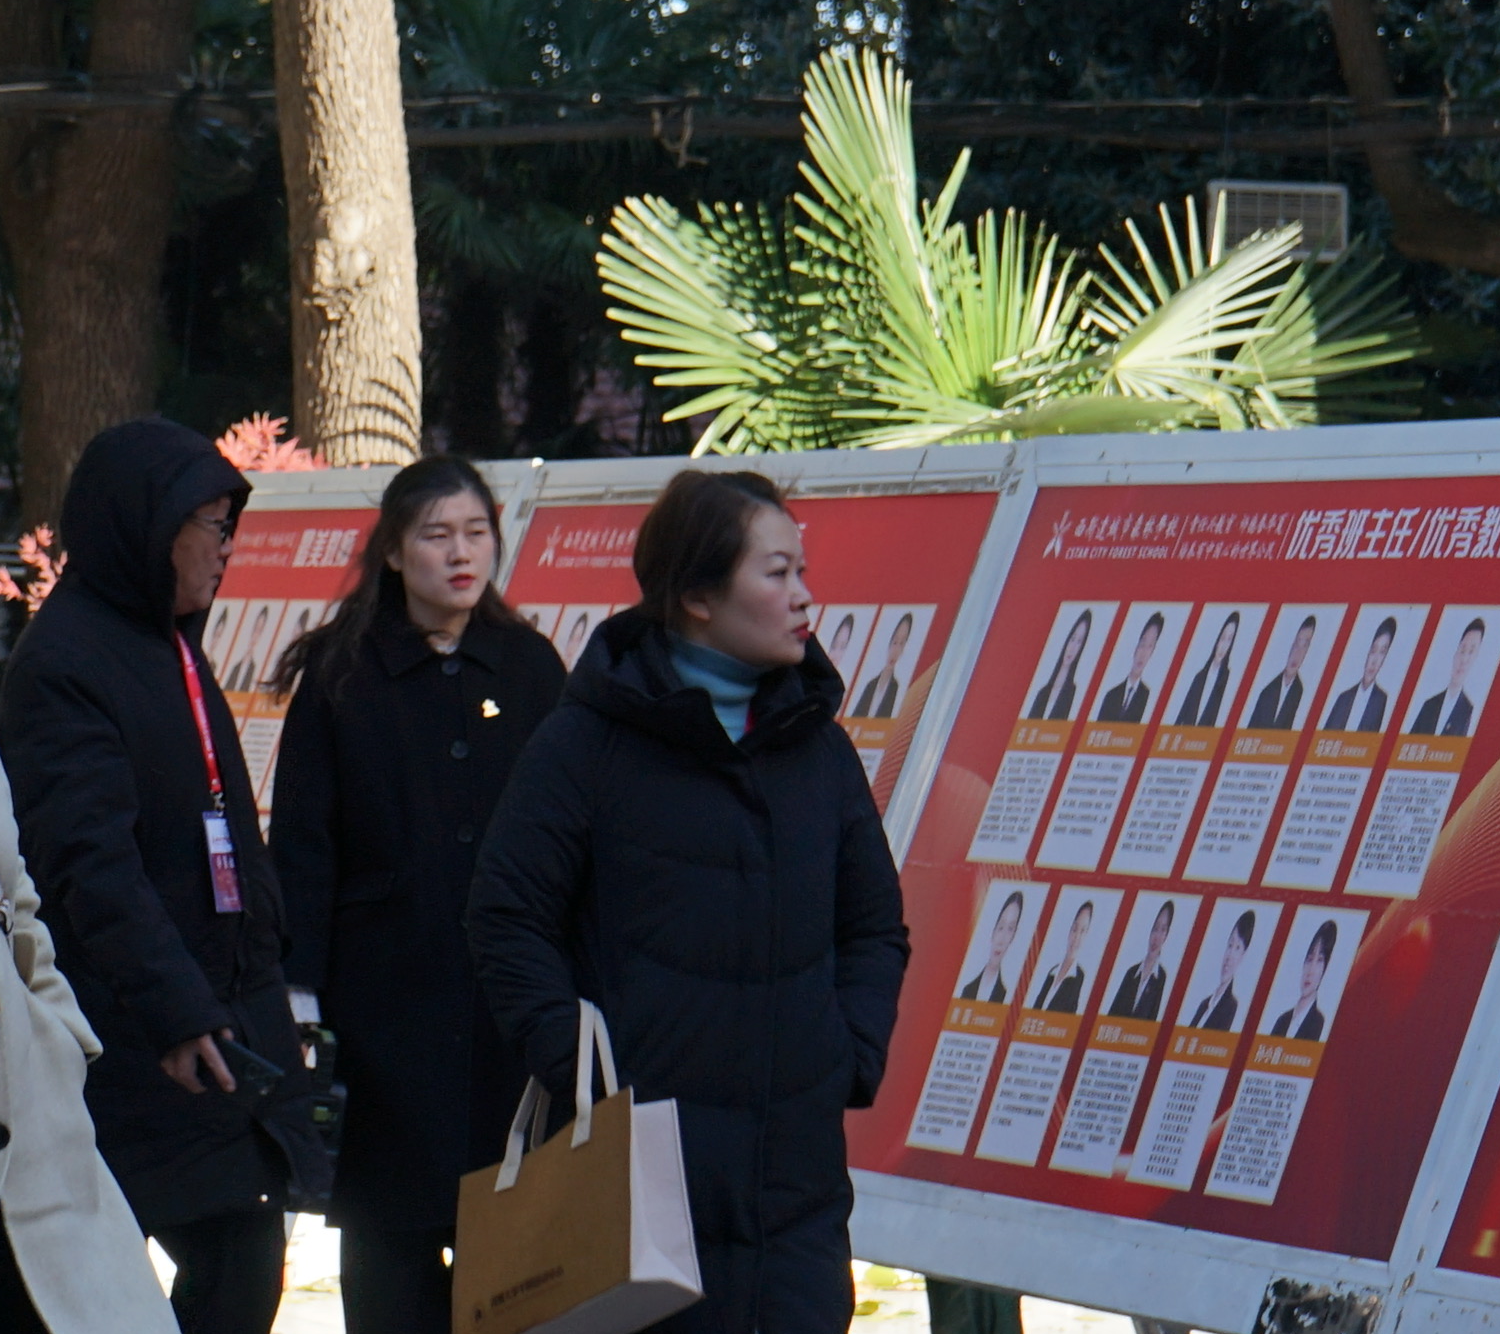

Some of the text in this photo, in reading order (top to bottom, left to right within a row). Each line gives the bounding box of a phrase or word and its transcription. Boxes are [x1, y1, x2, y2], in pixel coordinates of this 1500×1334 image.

[1089, 546, 1109, 559] CITY
[1108, 546, 1138, 559] FOREST
[1137, 546, 1169, 559] SCHOOL
